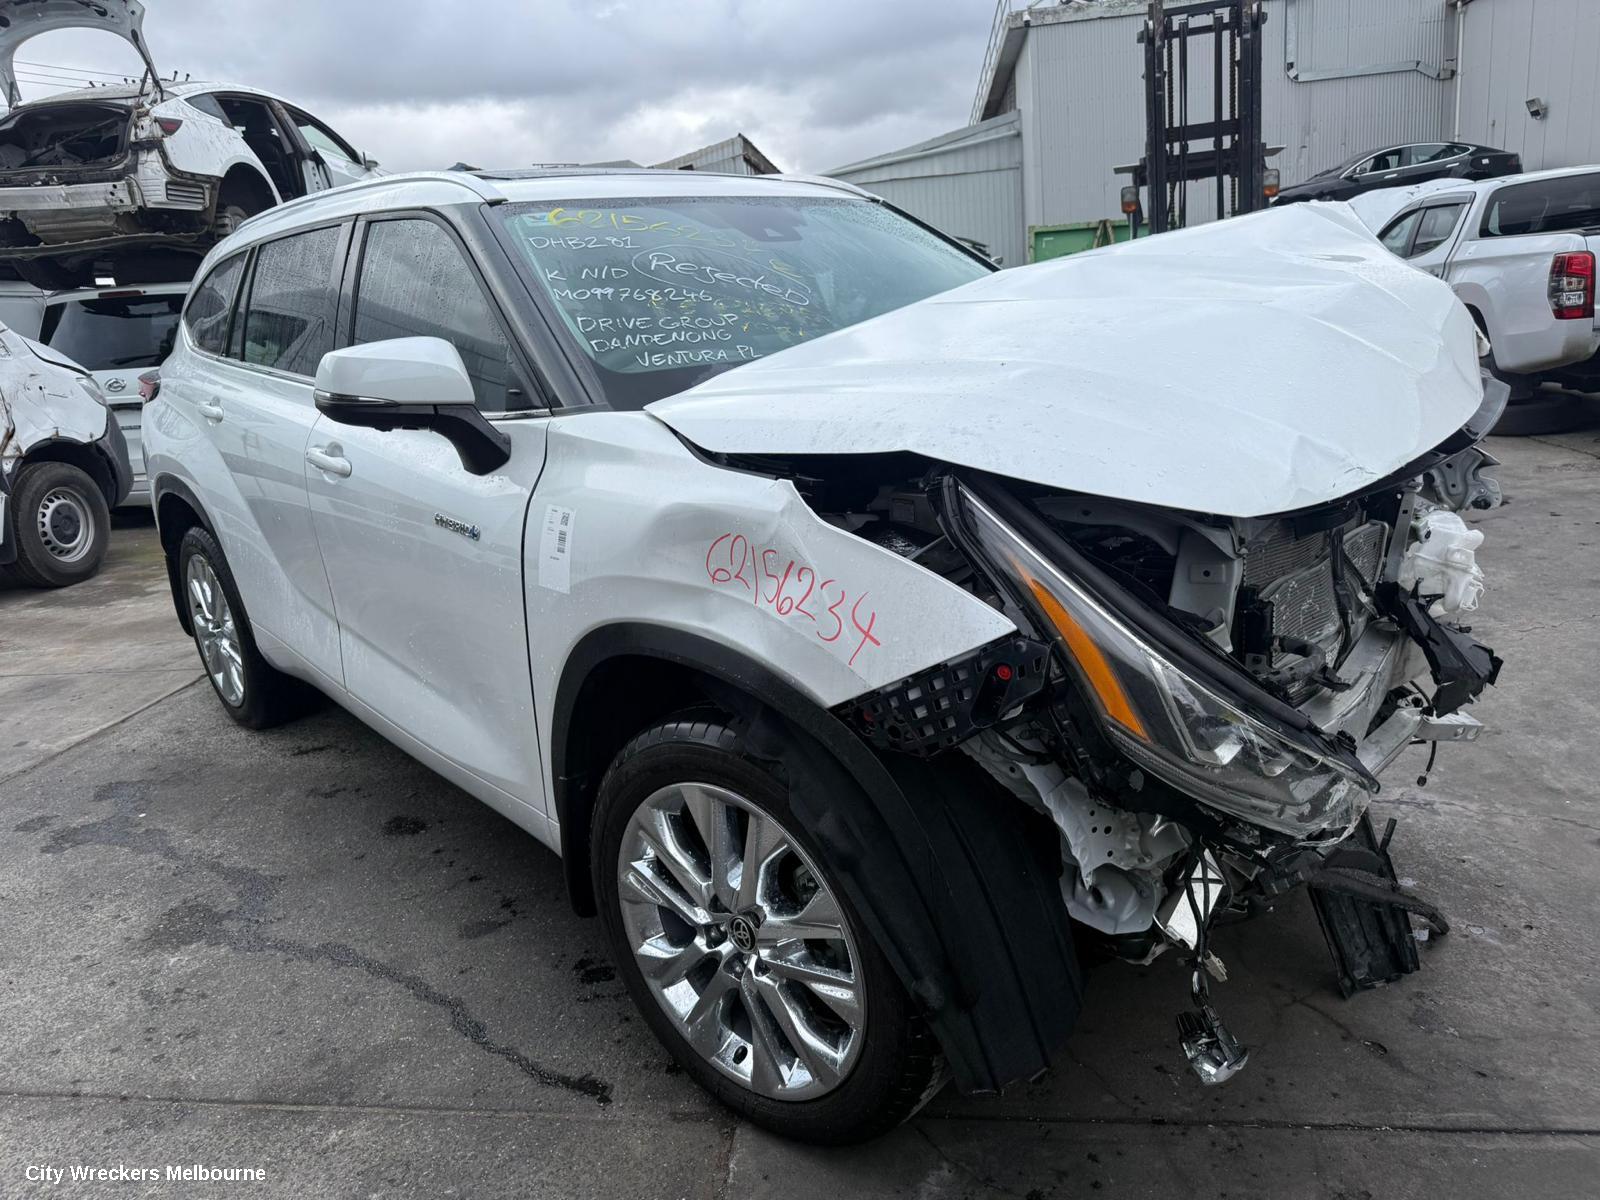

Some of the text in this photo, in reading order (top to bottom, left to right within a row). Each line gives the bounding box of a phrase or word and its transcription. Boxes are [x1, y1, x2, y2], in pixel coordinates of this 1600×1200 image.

[528, 235, 641, 249] DHB281
[576, 313, 739, 333] DRIVE GROUP
[590, 329, 732, 352] DANDENONG
[636, 344, 763, 367] VENTURA PL
[706, 532, 881, 666] 62156234
